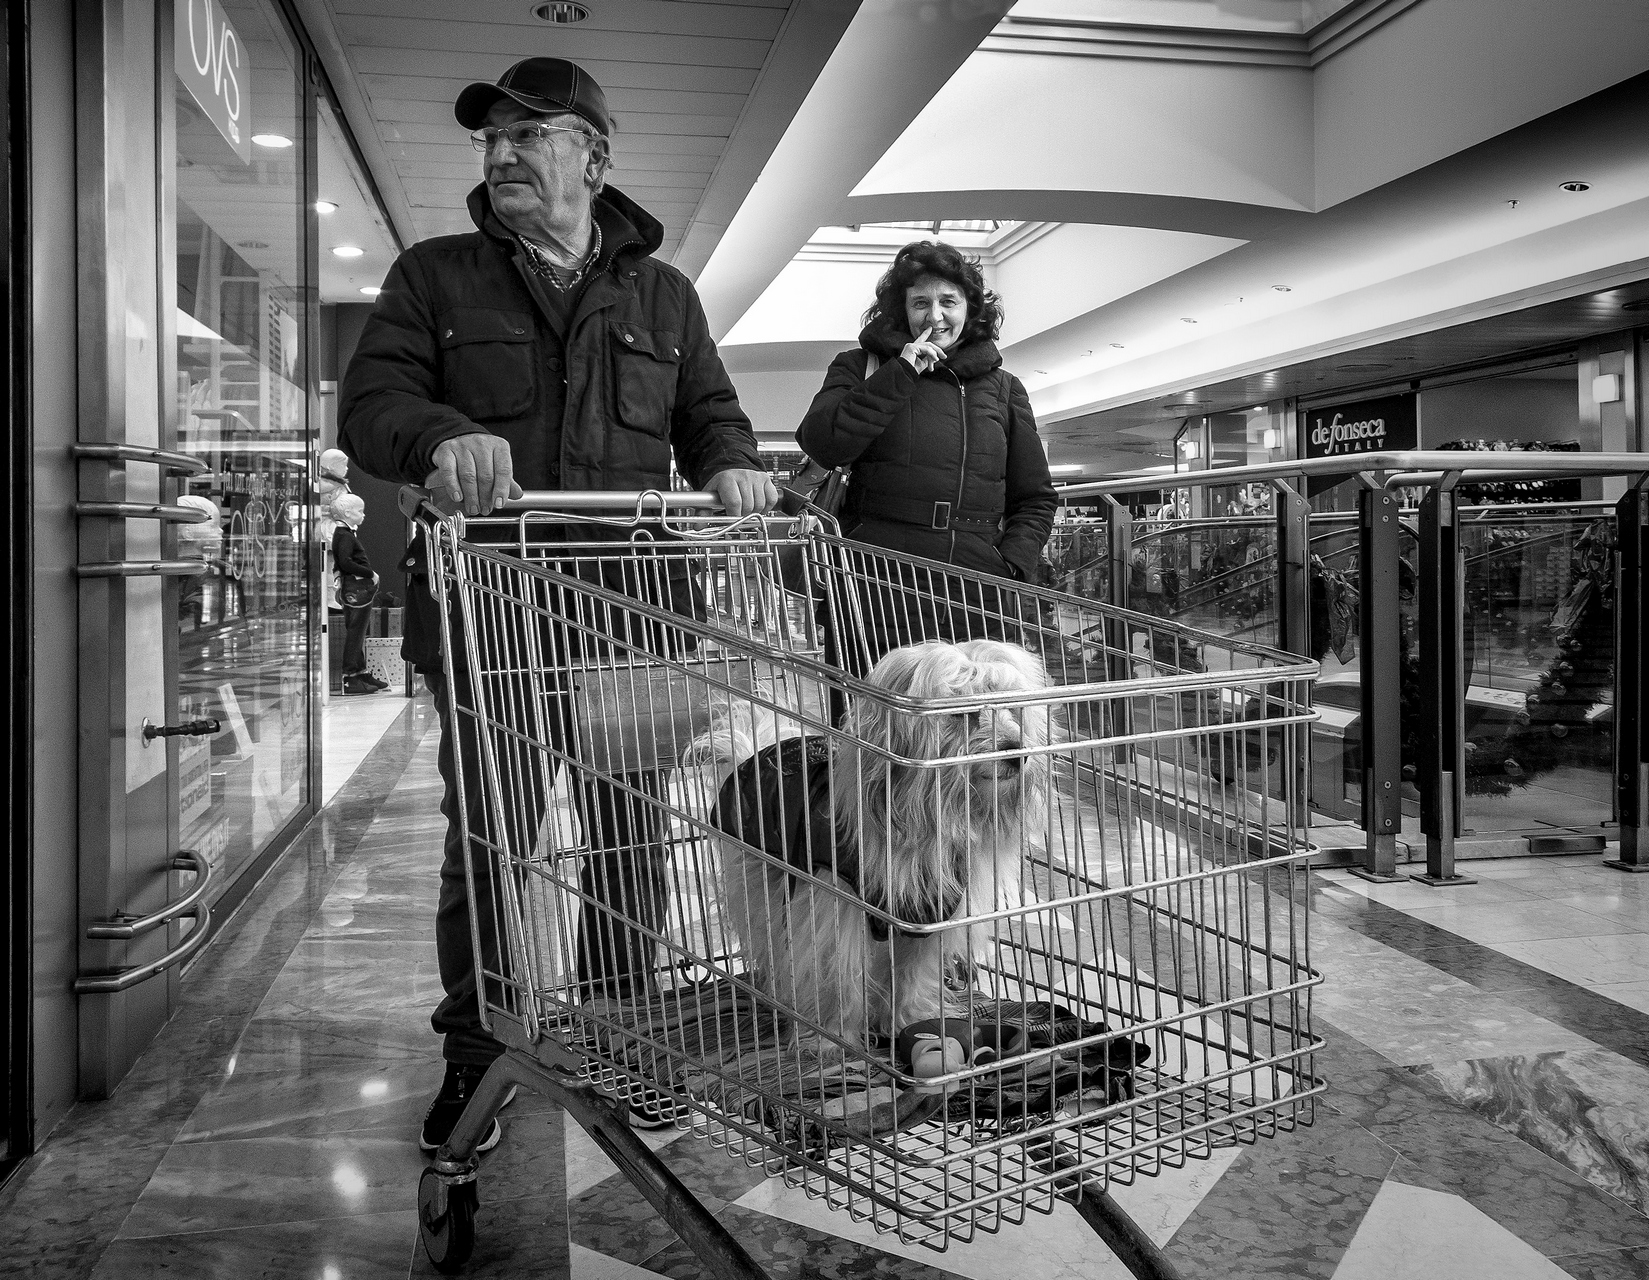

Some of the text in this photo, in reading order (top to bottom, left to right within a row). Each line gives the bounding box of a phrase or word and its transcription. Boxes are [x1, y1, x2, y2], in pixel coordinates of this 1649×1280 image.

[188, 0, 240, 121] OVS
[1335, 439, 1384, 453] ITALY
[245, 501, 299, 523] OVS
